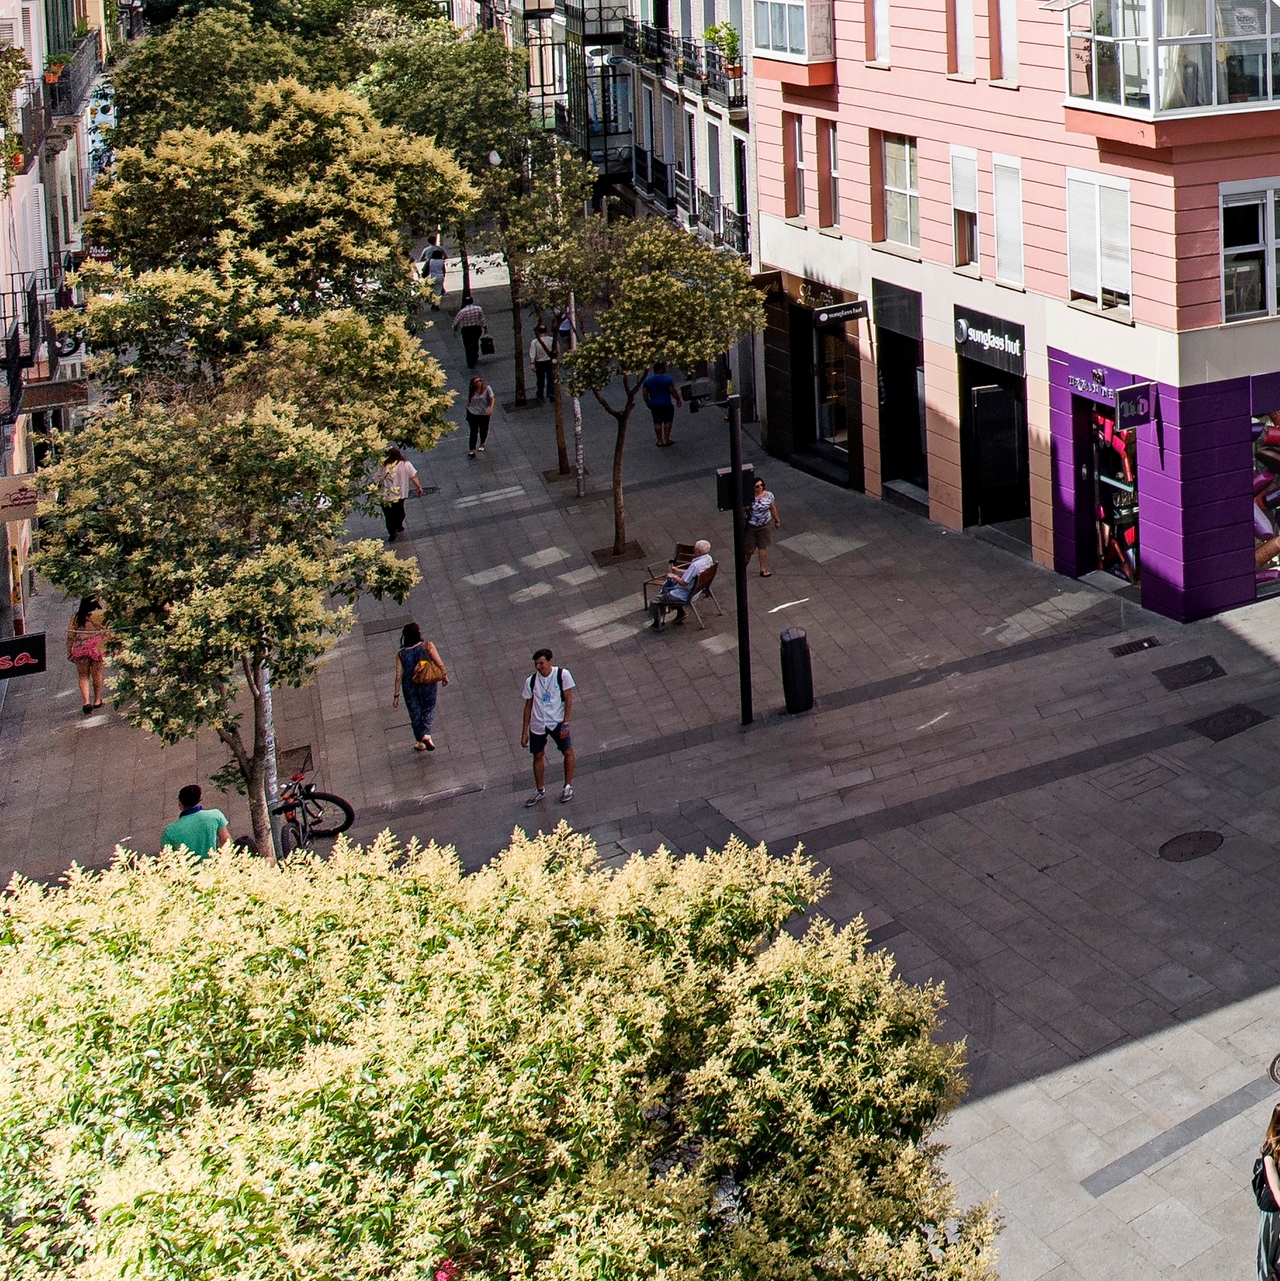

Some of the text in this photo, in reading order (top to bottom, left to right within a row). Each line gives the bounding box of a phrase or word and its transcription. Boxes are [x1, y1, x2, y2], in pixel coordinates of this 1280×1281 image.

[967, 327, 1021, 356] sunglass hut
[0, 652, 39, 669] sa
